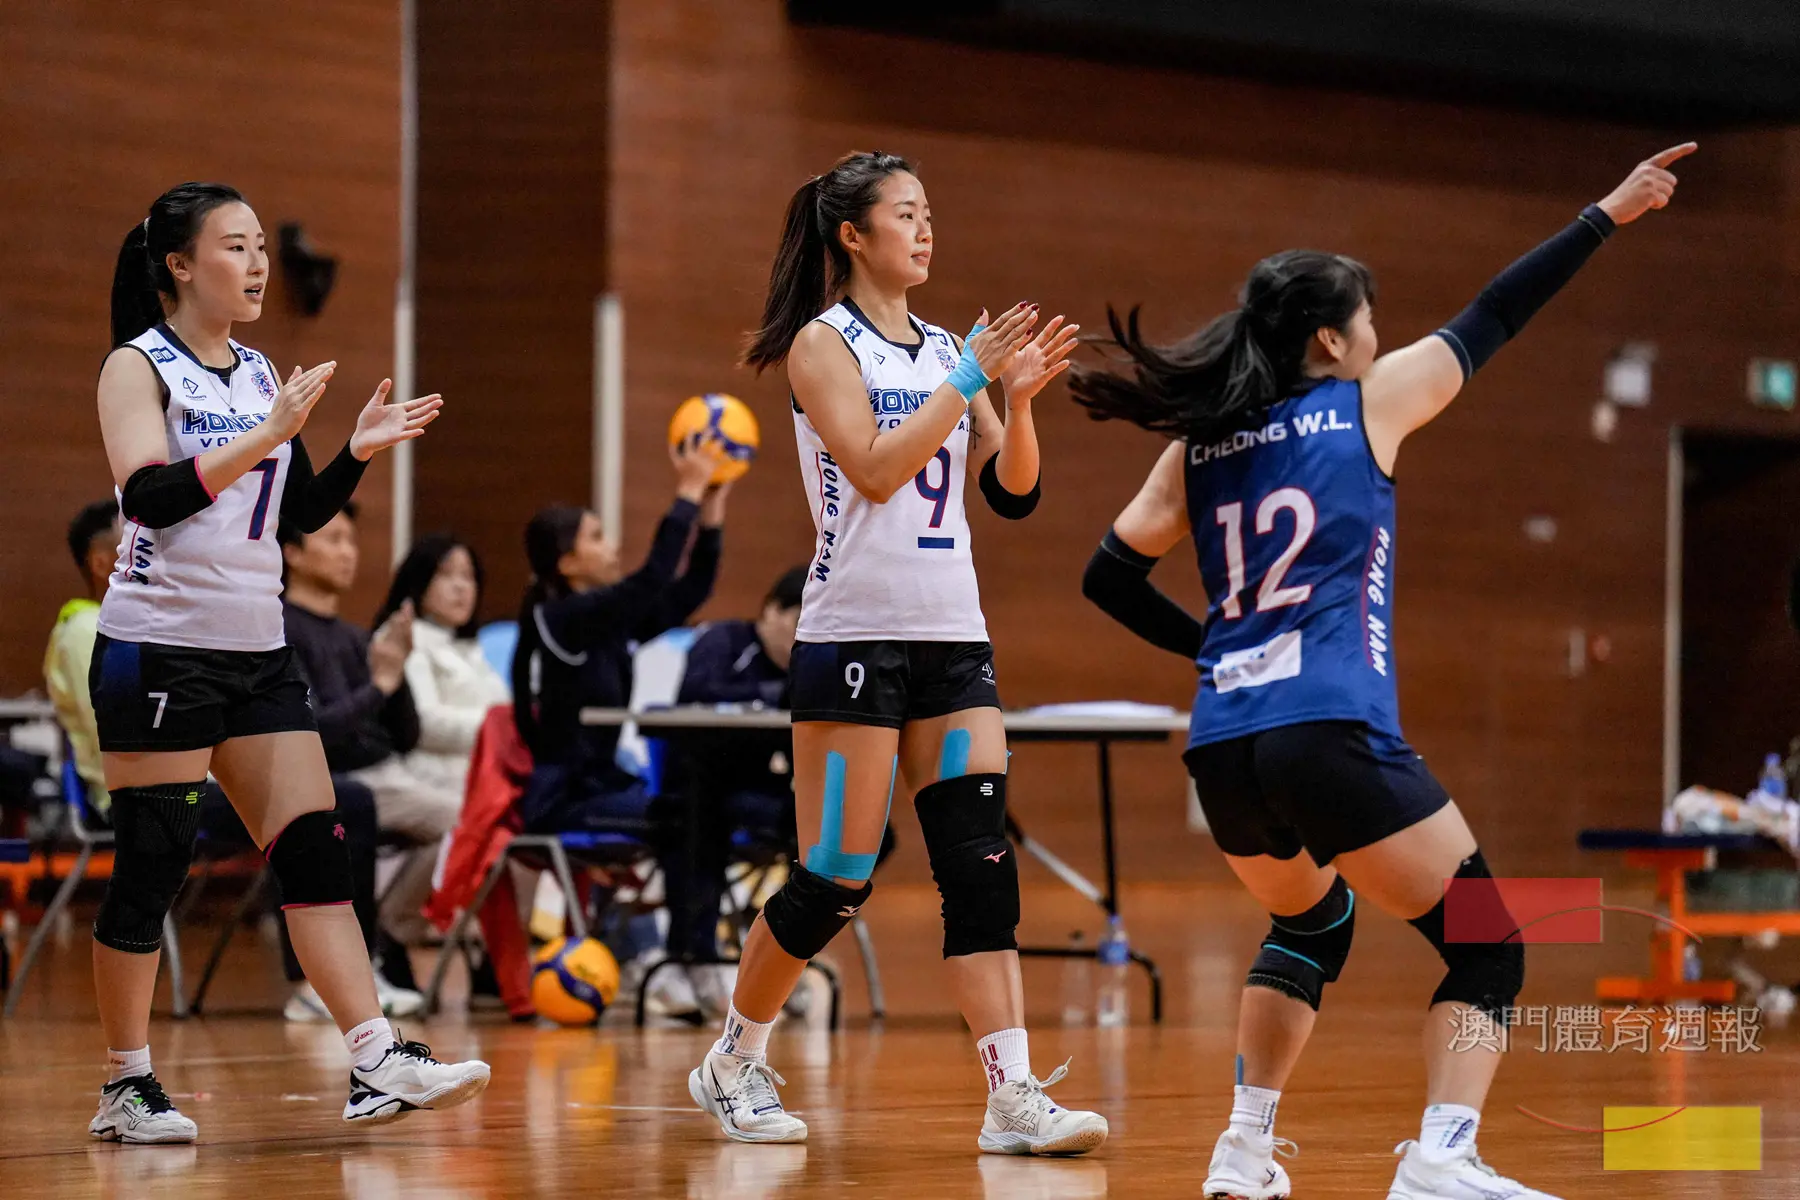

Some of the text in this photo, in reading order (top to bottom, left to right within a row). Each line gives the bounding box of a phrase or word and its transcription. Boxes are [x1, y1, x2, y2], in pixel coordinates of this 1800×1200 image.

[1190, 409, 1353, 466] CHEONG W.L.
[248, 458, 279, 541] 7
[914, 445, 951, 529] 9
[1215, 487, 1317, 620] 12
[1367, 527, 1391, 677] HONG NAM
[148, 692, 168, 729] 7
[844, 662, 865, 699] 9
